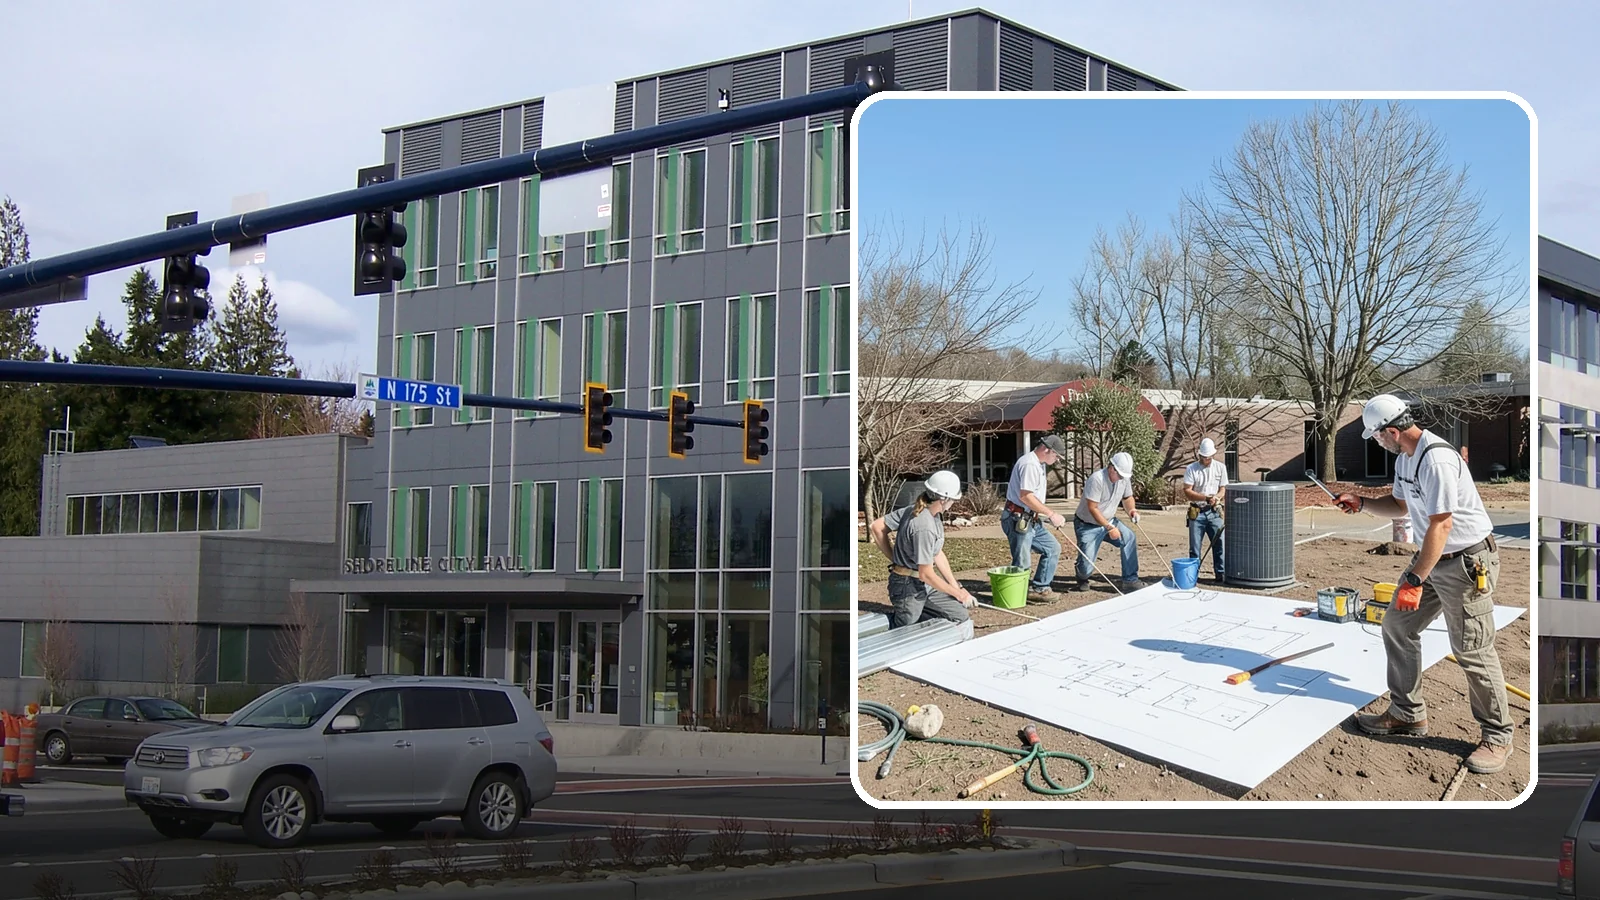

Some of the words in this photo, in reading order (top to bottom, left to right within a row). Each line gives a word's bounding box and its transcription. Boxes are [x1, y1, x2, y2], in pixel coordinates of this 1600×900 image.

[387, 380, 396, 400] N
[405, 382, 428, 403] 175
[436, 386, 452, 406] St
[344, 557, 432, 574] SHORELINE
[438, 556, 476, 573] CITY
[483, 555, 525, 572] HALL
